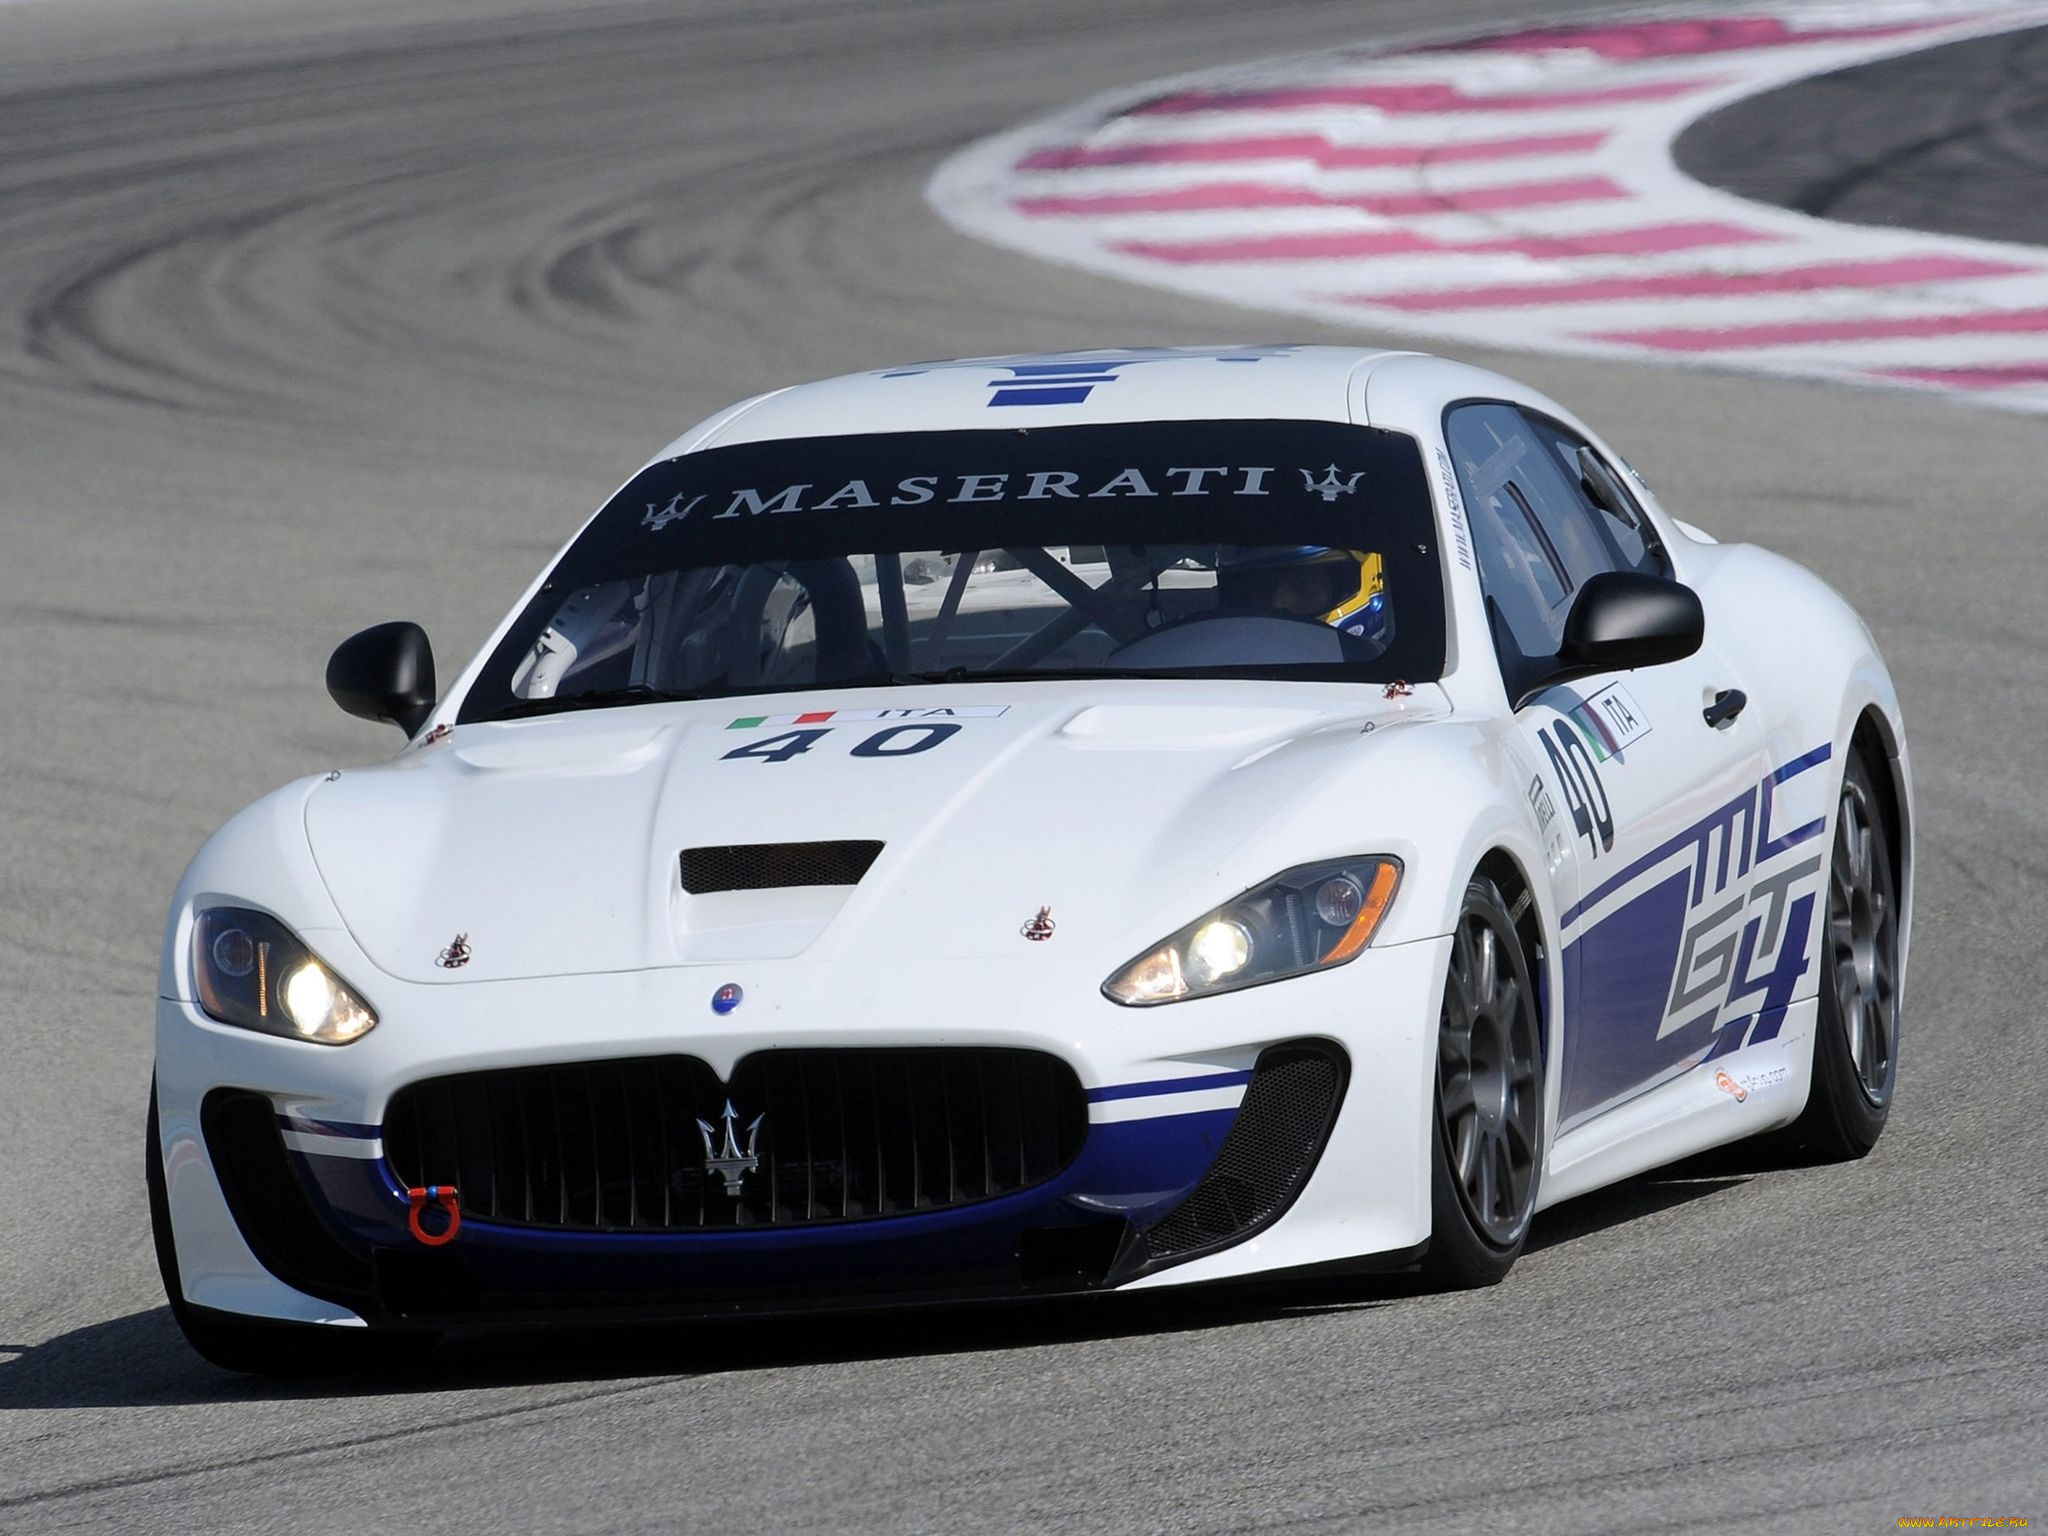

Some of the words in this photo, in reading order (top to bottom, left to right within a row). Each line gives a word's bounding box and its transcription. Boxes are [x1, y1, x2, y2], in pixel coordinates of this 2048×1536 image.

[713, 465, 1275, 519] MASERATI
[876, 707, 956, 718] ITA
[1600, 694, 1640, 736] ITA
[718, 723, 962, 764] 40
[1536, 718, 1615, 860] 40
